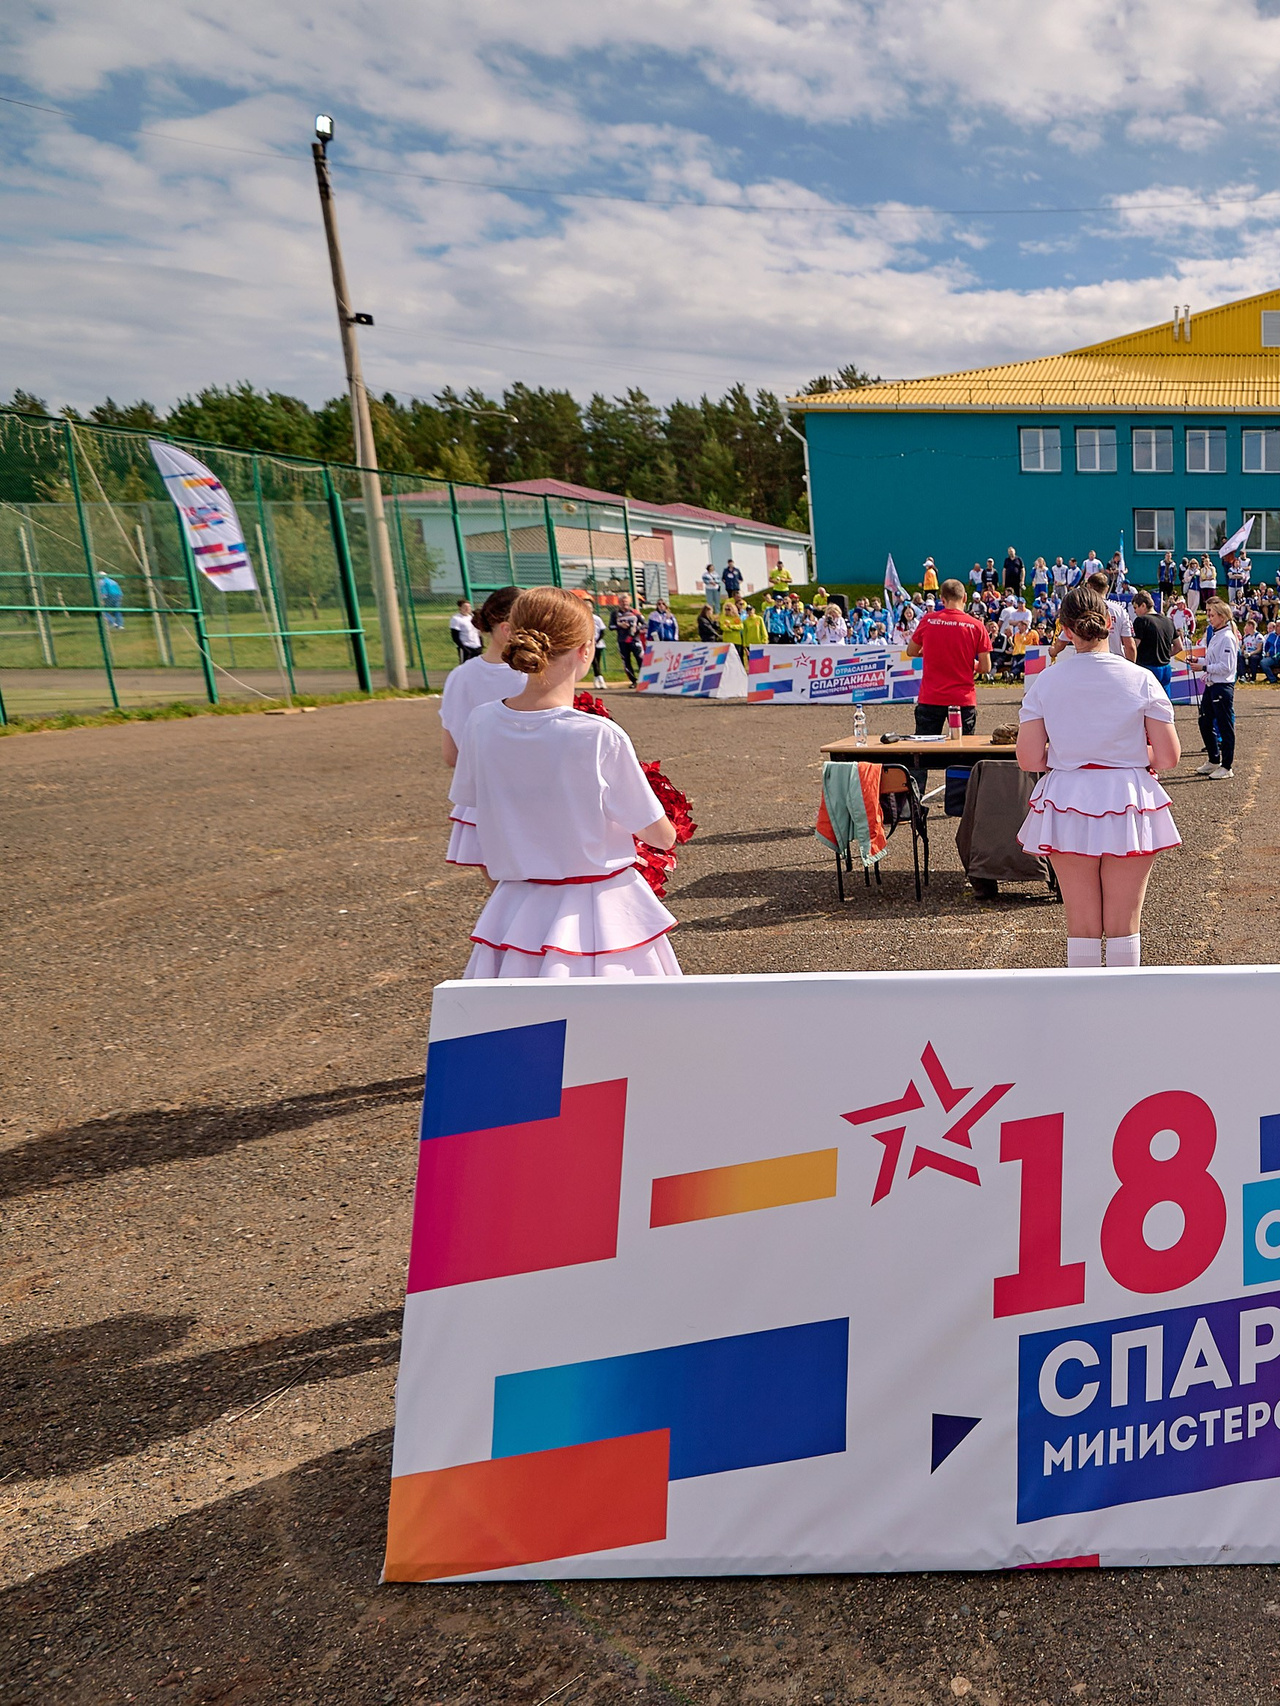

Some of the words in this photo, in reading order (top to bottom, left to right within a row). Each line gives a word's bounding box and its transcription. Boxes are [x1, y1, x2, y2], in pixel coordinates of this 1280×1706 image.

[667, 652, 682, 672] 18
[808, 657, 833, 680] 18
[835, 663, 877, 676] ОТРАСЛЕВАЯ
[811, 671, 885, 690] СПАРТАКИАДА
[994, 1089, 1227, 1319] 18
